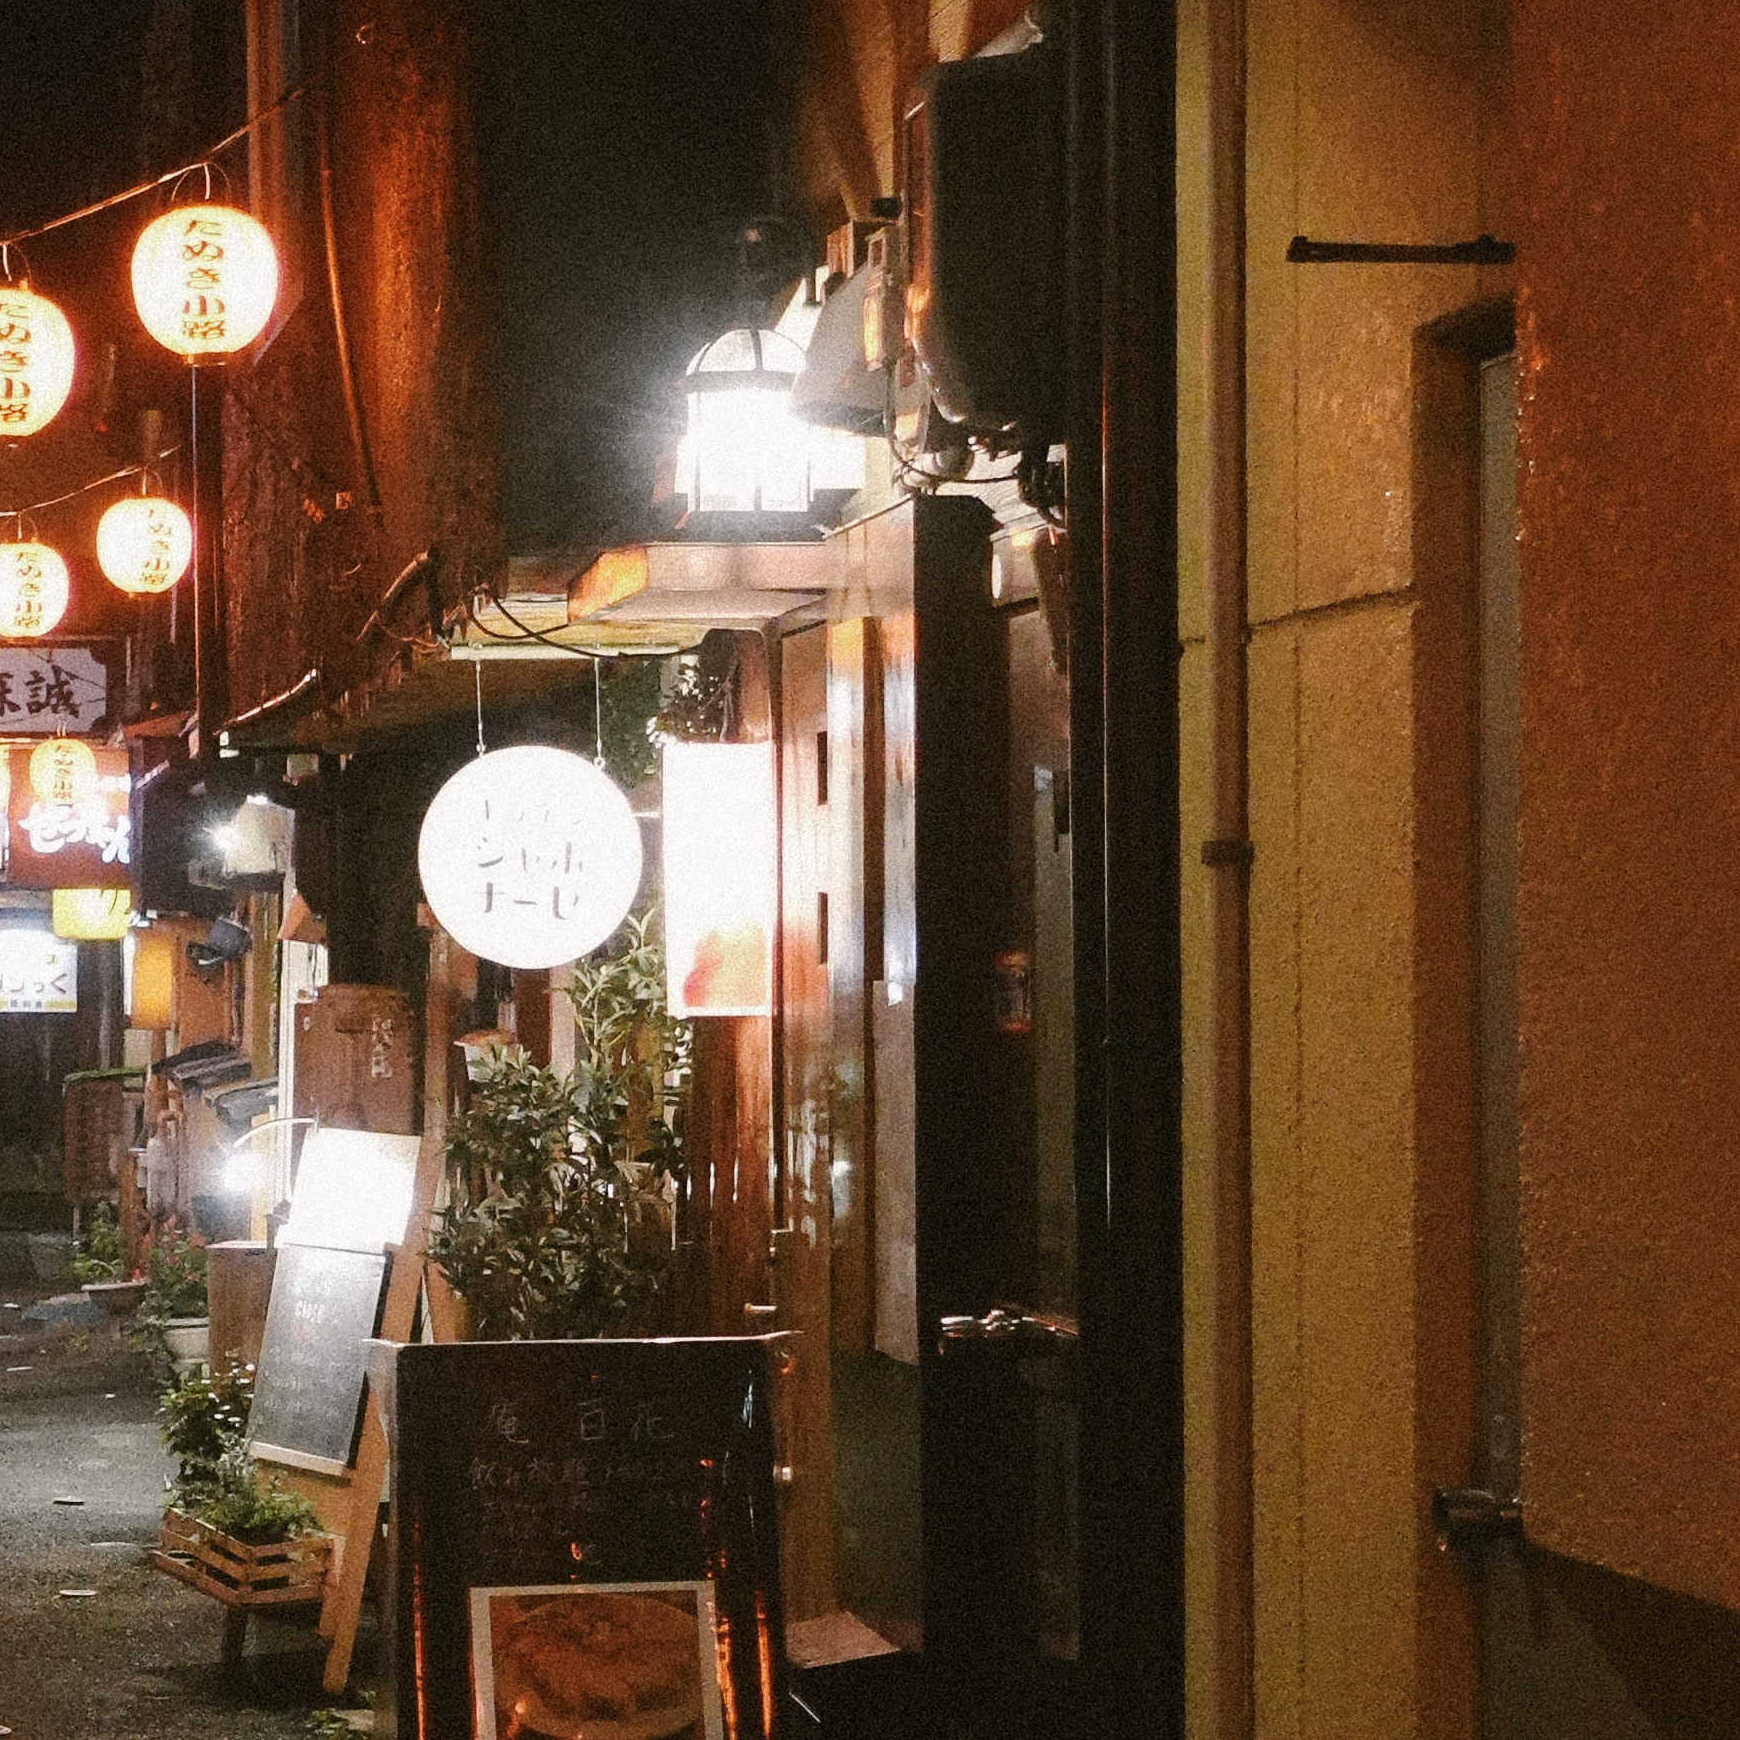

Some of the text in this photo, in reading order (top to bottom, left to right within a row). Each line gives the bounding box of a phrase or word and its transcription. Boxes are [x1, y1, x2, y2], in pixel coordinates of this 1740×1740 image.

[182, 219, 226, 340] たぬき小路
